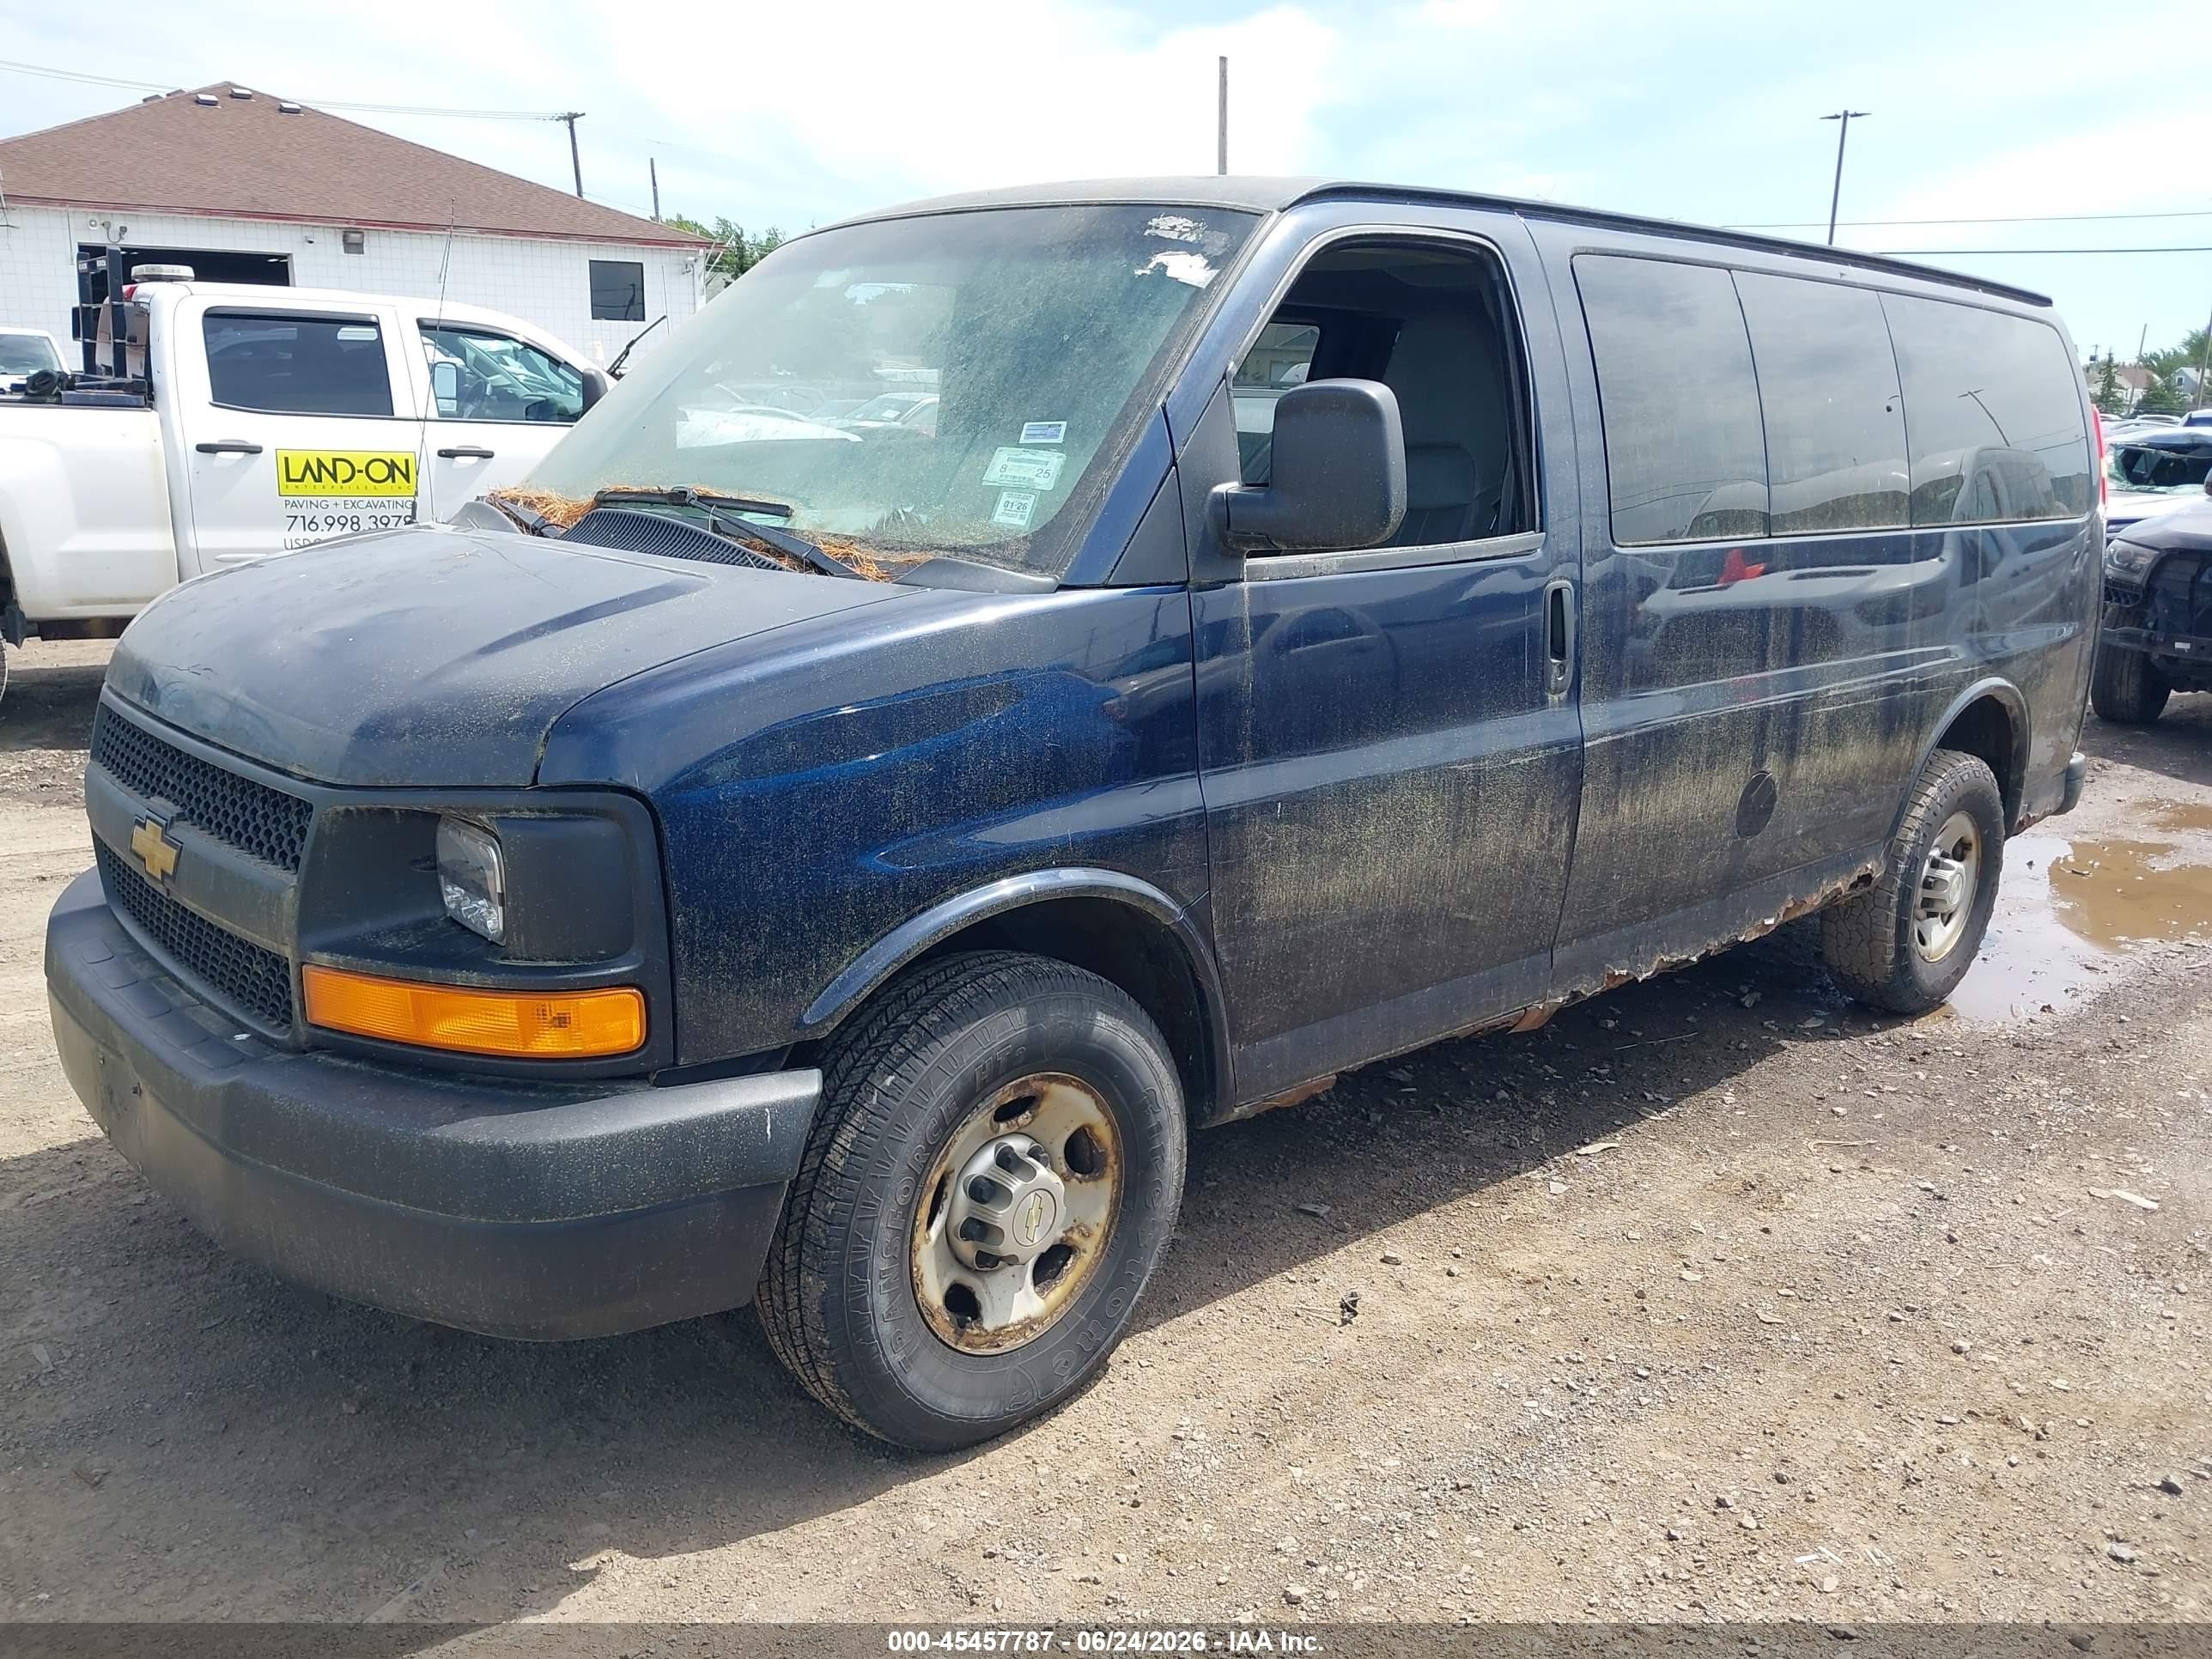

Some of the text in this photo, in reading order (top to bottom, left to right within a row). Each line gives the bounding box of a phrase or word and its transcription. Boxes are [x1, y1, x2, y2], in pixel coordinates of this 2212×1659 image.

[283, 456, 411, 483] LAND-ON
[999, 464, 1052, 479] 8 25
[284, 499, 330, 509] PAVING
[343, 500, 413, 510] EXCAVATING
